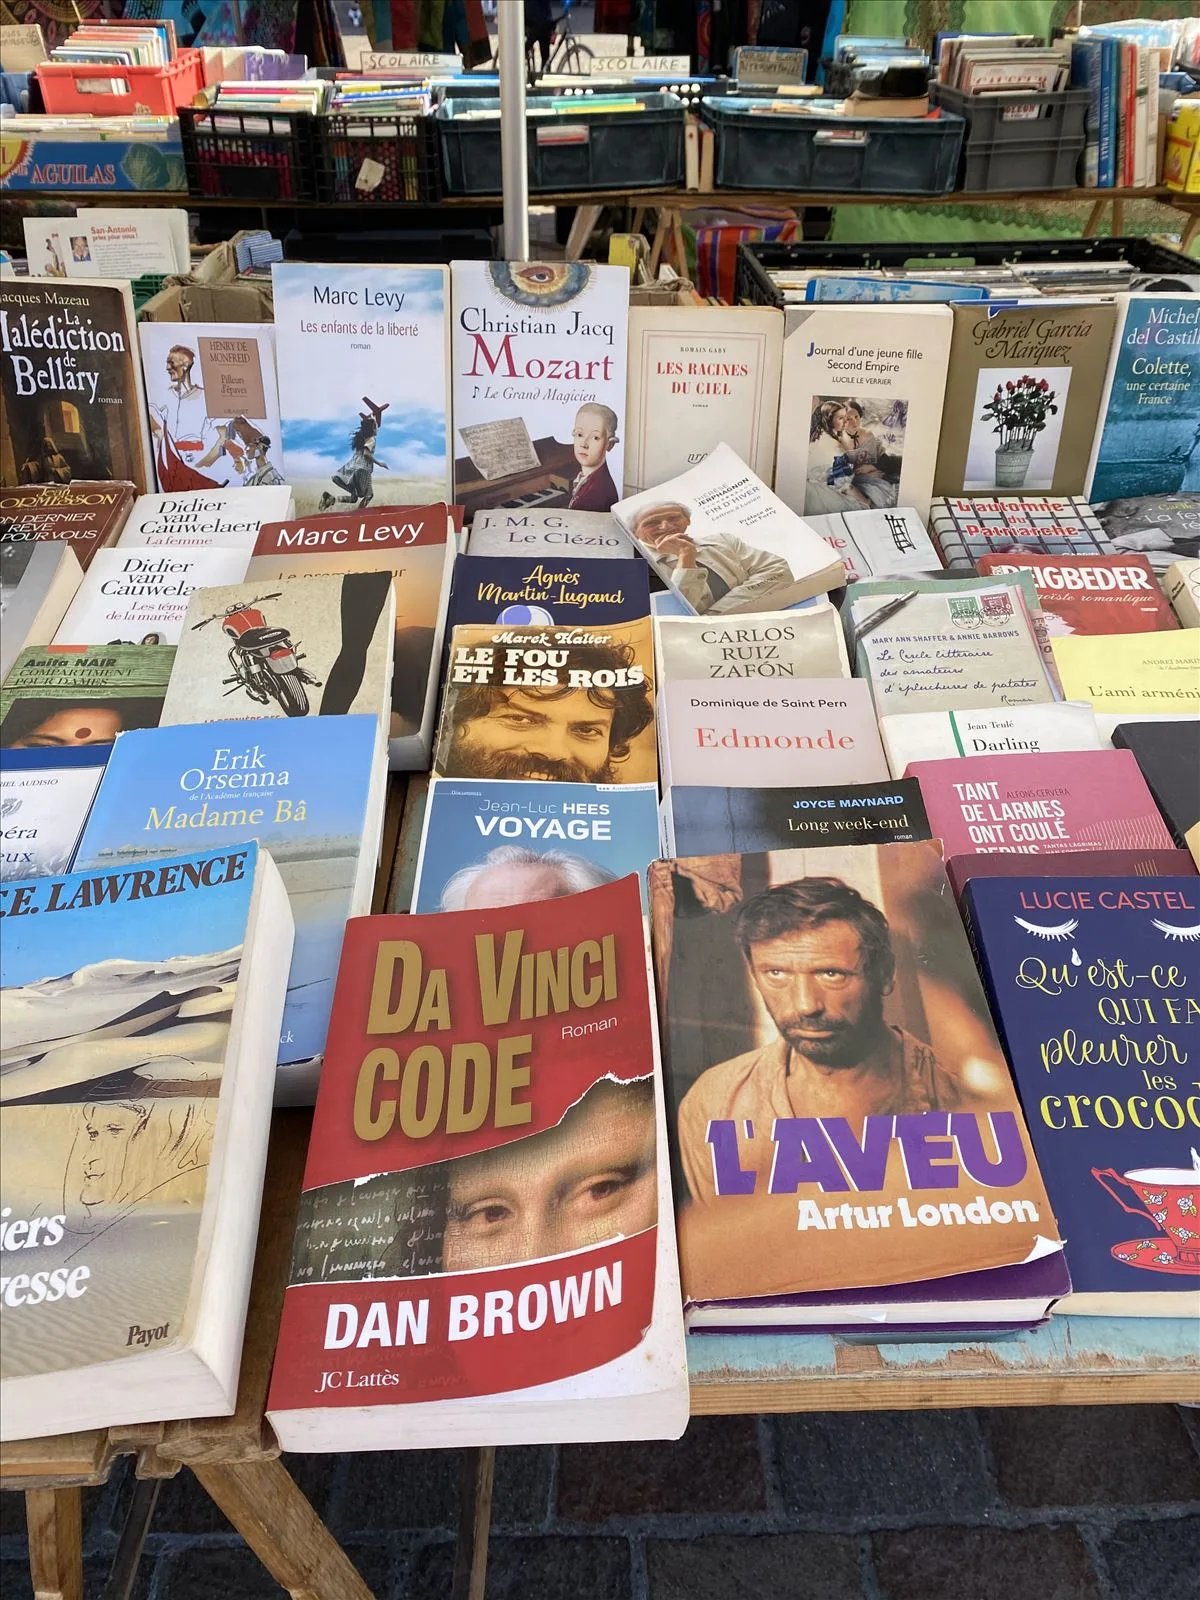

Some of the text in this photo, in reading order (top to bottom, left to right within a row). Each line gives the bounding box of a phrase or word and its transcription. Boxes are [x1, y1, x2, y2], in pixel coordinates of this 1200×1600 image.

[368, 54, 441, 69] SCOLAIRE
[596, 58, 678, 71] SCOLAIRE
[30, 163, 117, 184] AGUILAS
[45, 292, 90, 306] Mazeau
[313, 286, 405, 312] Marc Levy
[1147, 307, 1199, 325] Michel
[300, 319, 419, 338] Les enfants de la liberté
[460, 307, 615, 346] Christian Jacq
[972, 319, 1094, 346] Gabriel García
[1127, 328, 1151, 346] del
[210, 341, 248, 352] HENRY DE
[807, 342, 924, 361] Journal d'une jeune fille
[985, 340, 1073, 365] Márquez
[63, 353, 77, 368] de
[210, 353, 251, 363] MONFREID
[462, 333, 615, 381] Mozart
[657, 362, 749, 377] LES RACINES
[827, 359, 900, 373] Second Empire
[1132, 357, 1192, 377] Colette,
[9, 355, 99, 404] Bellary
[832, 376, 892, 386] LUCILE VERRIER
[1126, 380, 1191, 392] une certaine
[484, 387, 597, 405] Le Grand Magicien
[671, 381, 732, 396] DU CIEL
[1138, 394, 1173, 406] France
[698, 477, 750, 507] JERPHAGNON
[159, 499, 227, 515] Didier
[705, 506, 723, 517] FIN
[956, 500, 1065, 513] L'automne
[21, 512, 97, 523] DERNIER
[162, 514, 198, 524] van
[481, 516, 569, 529] J. M. G.
[1007, 515, 1028, 525] du
[1144, 514, 1172, 523] La
[140, 520, 263, 535] Cauwelaert
[277, 522, 425, 547] Marc Levy
[966, 524, 1079, 537] Patriarche
[1, 530, 98, 542] POUR VOUS
[165, 537, 213, 545] femme
[508, 532, 620, 547] Le Clézio
[122, 558, 194, 573] Didier
[128, 574, 164, 584] van
[521, 565, 581, 590] Agnès
[477, 583, 624, 609] Martin-Lugand
[1080, 593, 1154, 607] romantique
[139, 612, 183, 622] mariée
[554, 628, 612, 646] Halter
[701, 627, 796, 645] CARLOS
[913, 634, 947, 643] SHAFFER
[455, 647, 570, 668] LE FOU
[721, 646, 780, 660] RUIZ
[24, 658, 117, 668] Anita NAIR
[709, 662, 795, 678] ZAFÓN
[903, 665, 964, 675] amateurs
[19, 668, 136, 677] COMPARTIMENT
[452, 665, 645, 688] ET LES ROIS
[14, 678, 109, 686] POUR DAMES
[992, 679, 1039, 692] patates
[1088, 686, 1136, 697] L'ami
[690, 698, 848, 710] Dominique de Saint Pern
[967, 719, 1015, 731] Jean Teulé
[695, 727, 856, 751] Edmonde
[972, 737, 1041, 752] Darling
[211, 745, 267, 771] Erik
[19, 779, 59, 787] AUDISIO
[180, 767, 290, 792] Orsenna
[953, 782, 1000, 801] TANT
[1006, 788, 1070, 799] ALFONS CERVERA
[479, 799, 610, 815] Jean-Luc HEES
[793, 796, 904, 810] JOYCE MAYNARD
[960, 799, 1065, 822] DE LARMES
[144, 799, 307, 831] Madame Bâ
[475, 815, 612, 841] VOYAGE
[788, 814, 909, 834] Long week-end
[968, 818, 1070, 844] ONT COULÉ
[44, 851, 249, 913] LAWRENCE
[1020, 891, 1196, 911] LUCIE CASTEL
[1098, 997, 1200, 1026] QUI FA
[561, 1016, 618, 1040] Roman
[1040, 1029, 1188, 1074] pleurer
[353, 1034, 533, 1142] CODE
[1142, 1069, 1177, 1091] les
[705, 1111, 1028, 1197] L'AVEU
[797, 1196, 1040, 1231] Artur London
[0, 1207, 66, 1252] iers
[323, 1260, 623, 1350] DAN BROWN
[126, 1322, 171, 1348] Payot
[314, 1368, 400, 1394] JC Lattès
